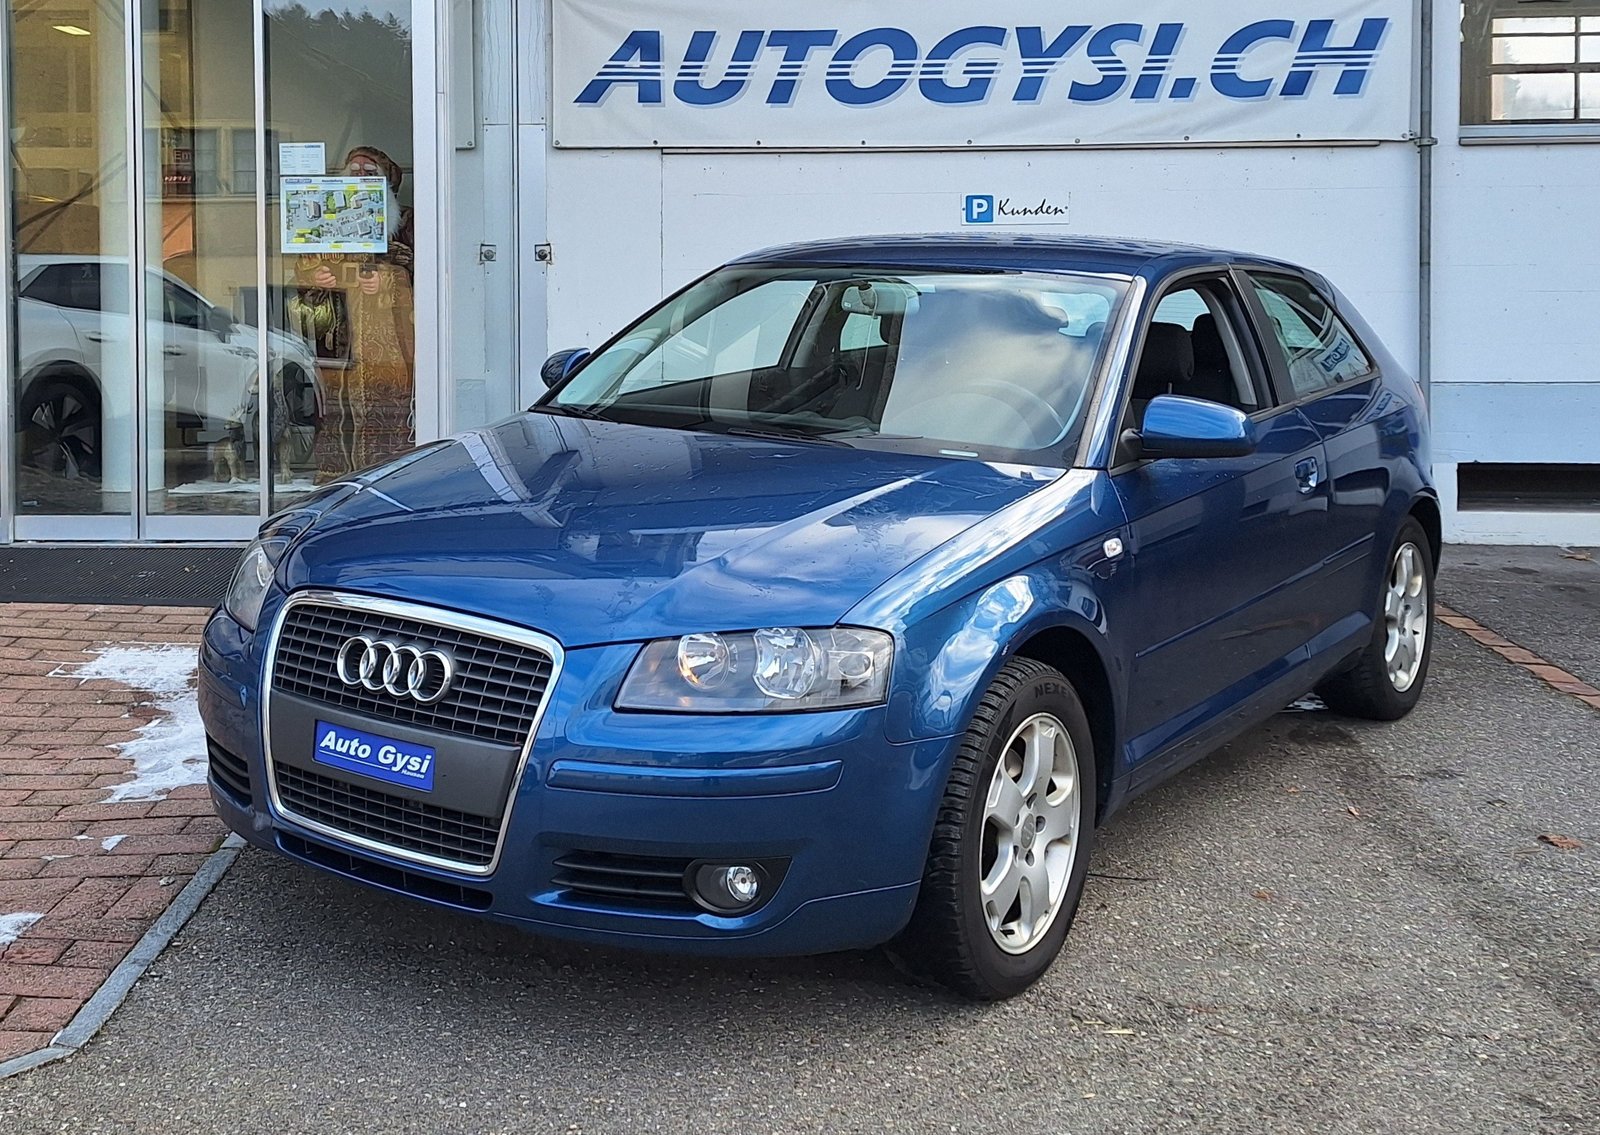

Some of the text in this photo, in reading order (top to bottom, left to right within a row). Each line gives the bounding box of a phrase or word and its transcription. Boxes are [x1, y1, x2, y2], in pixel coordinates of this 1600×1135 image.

[572, 16, 1391, 106] AUTOGYSI.CH
[972, 198, 1065, 220] P Kunden
[1034, 682, 1071, 699] NEXE
[319, 730, 432, 774] Auto Gysi
